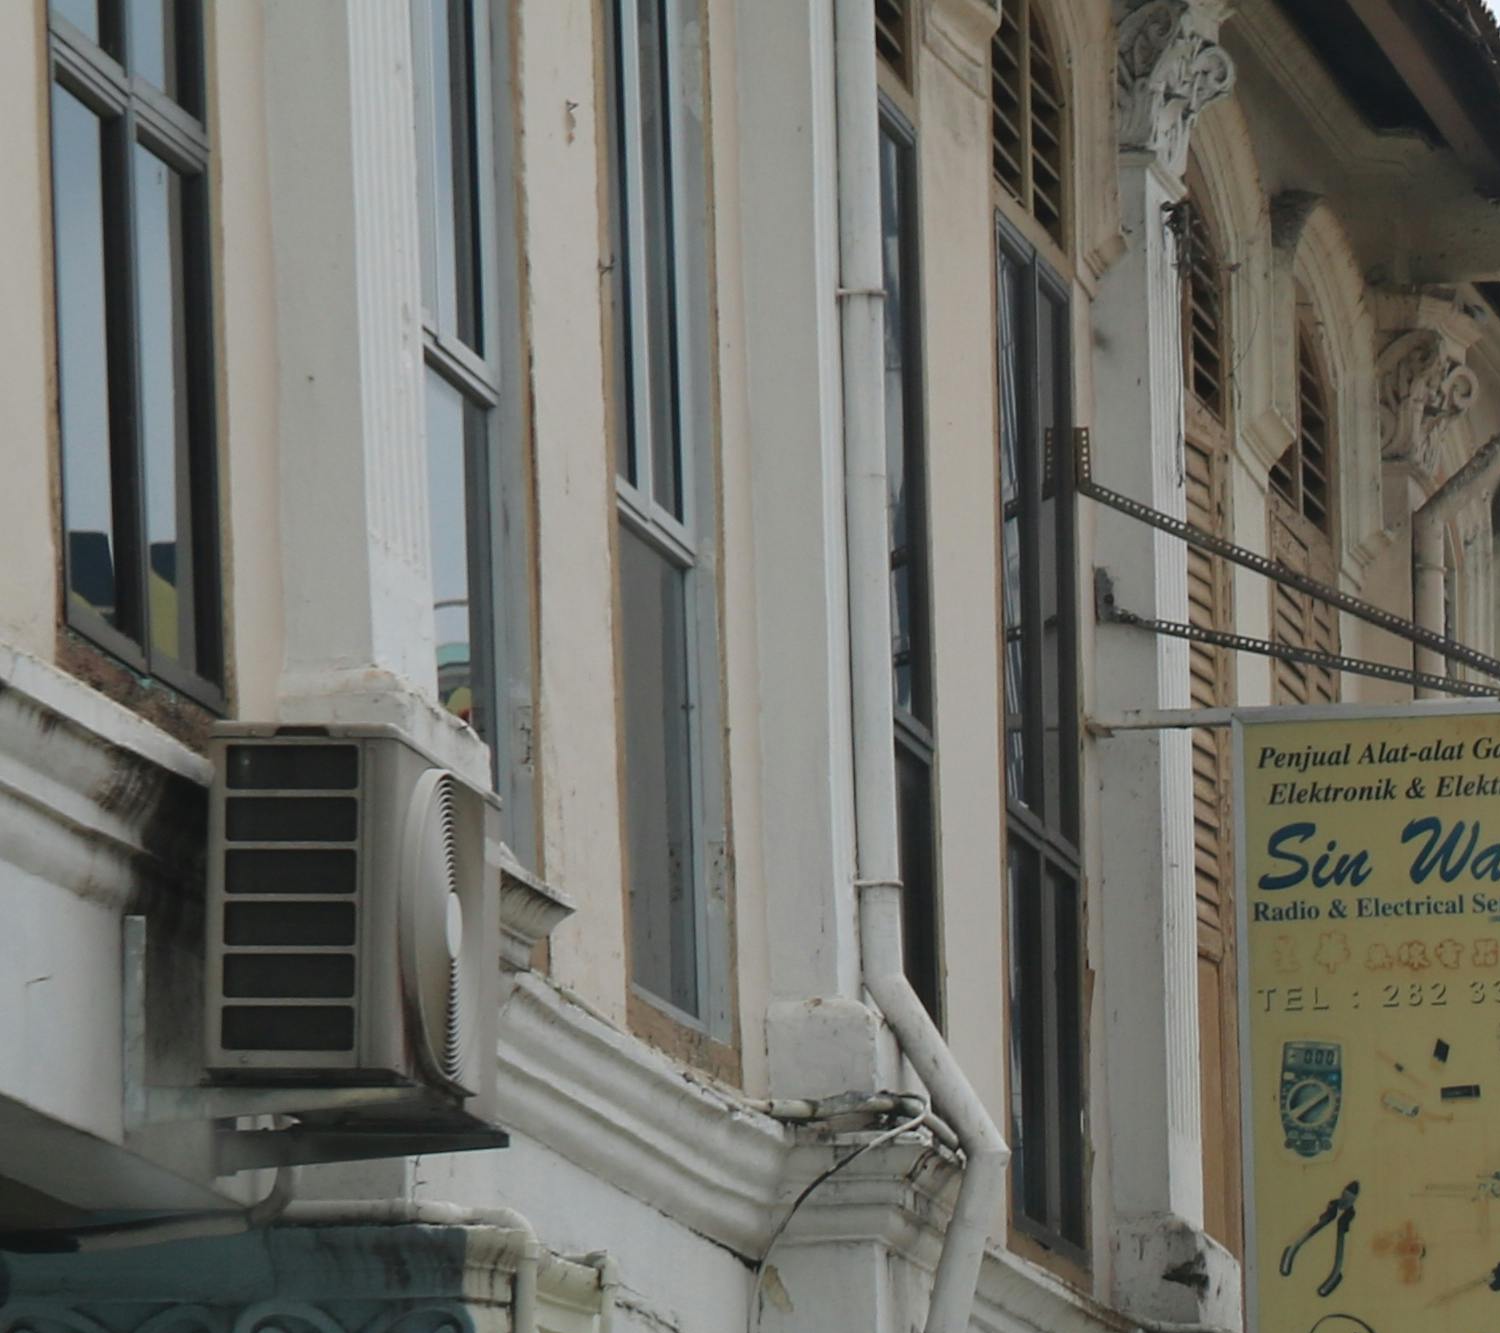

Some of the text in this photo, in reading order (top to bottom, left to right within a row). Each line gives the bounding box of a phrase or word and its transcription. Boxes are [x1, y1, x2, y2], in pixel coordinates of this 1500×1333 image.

[1257, 743, 1351, 773] Penjual
[1357, 739, 1465, 765] Alat-alat
[1268, 778, 1396, 805] Elektronik
[1405, 777, 1425, 800] &
[1257, 821, 1373, 890] Sin
[1253, 902, 1320, 923] Radio
[1327, 899, 1347, 919] &
[1357, 892, 1464, 918] Electrical
[1257, 987, 1330, 1012] TEL
